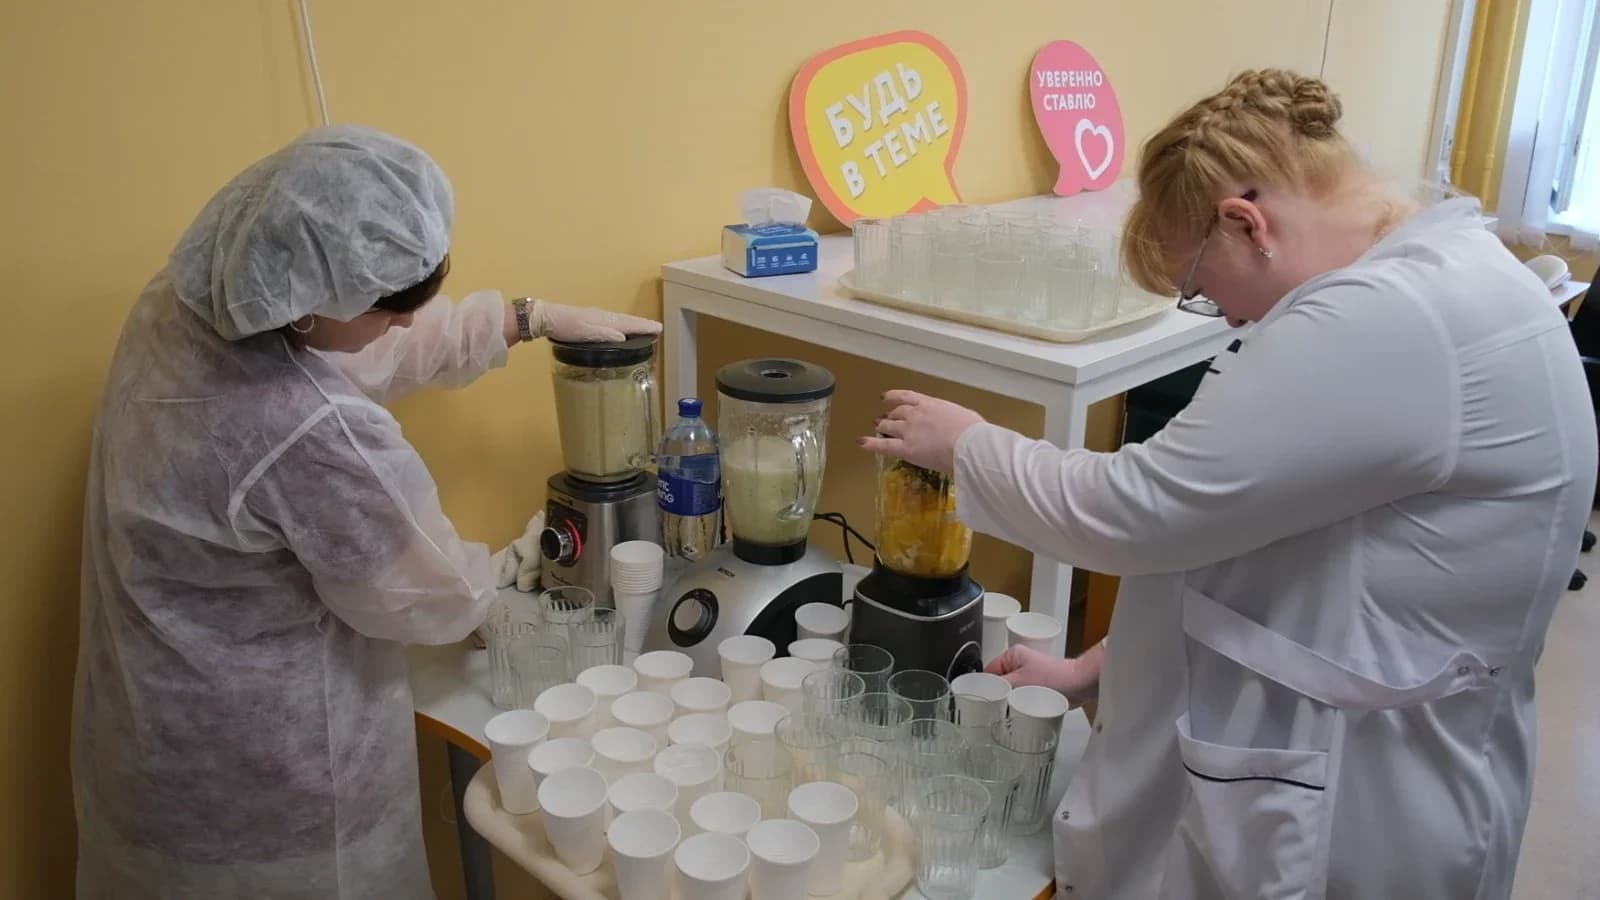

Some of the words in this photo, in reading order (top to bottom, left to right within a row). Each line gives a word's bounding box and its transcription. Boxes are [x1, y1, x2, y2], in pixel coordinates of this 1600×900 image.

[1037, 70, 1103, 88] УВЕРЕННО
[1043, 93, 1096, 111] СТАВЛЮ
[825, 62, 923, 149] БУДЬ
[839, 160, 866, 199] В
[864, 101, 949, 178] ТЕМЕ
